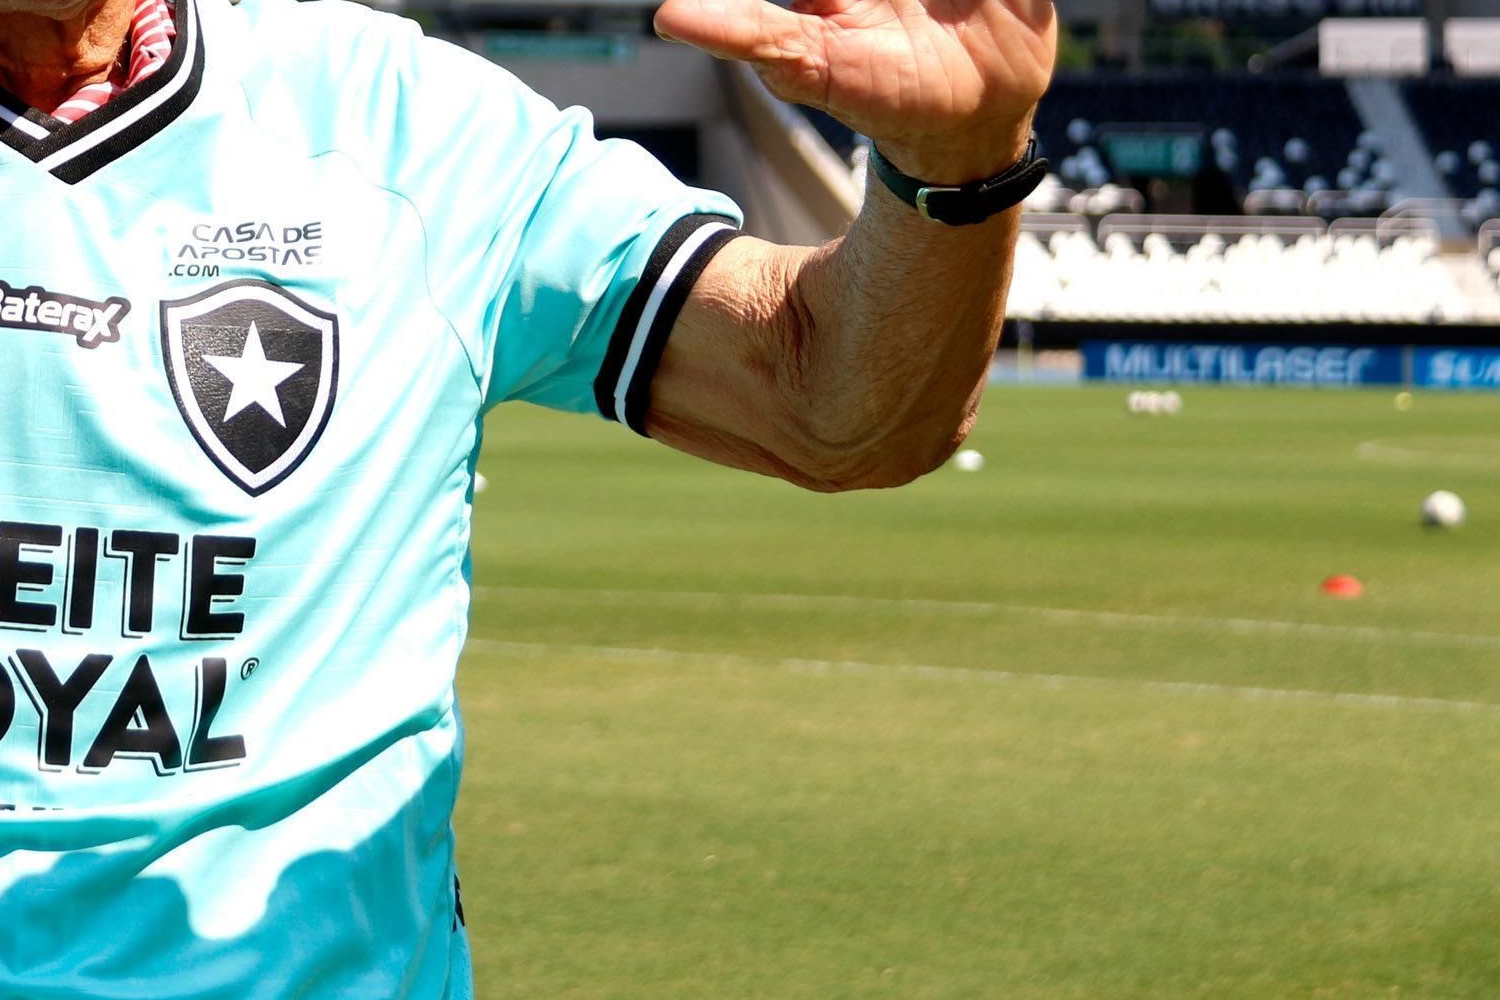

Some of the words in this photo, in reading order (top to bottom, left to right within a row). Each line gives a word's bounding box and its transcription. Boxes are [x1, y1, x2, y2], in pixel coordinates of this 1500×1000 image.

[192, 222, 275, 243] CASA
[283, 221, 322, 244] DE
[177, 244, 322, 266] APOSTAS
[168, 263, 220, 278] .COM
